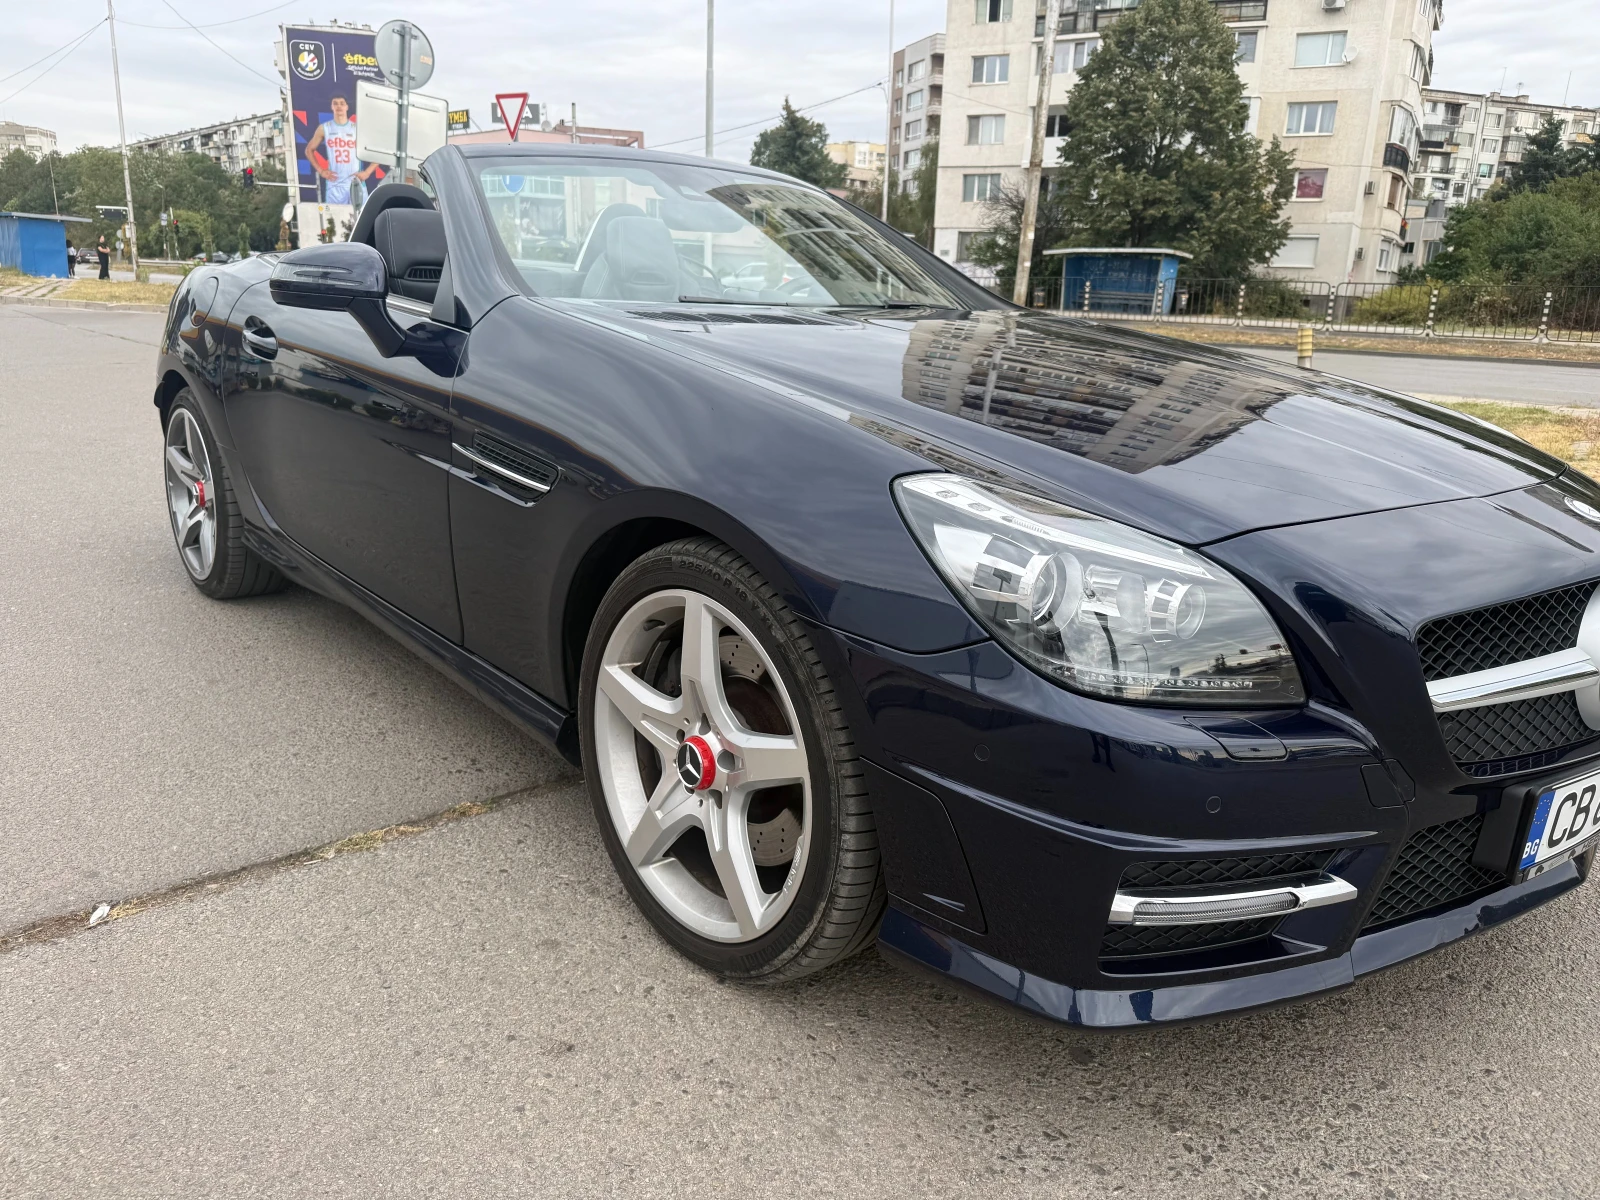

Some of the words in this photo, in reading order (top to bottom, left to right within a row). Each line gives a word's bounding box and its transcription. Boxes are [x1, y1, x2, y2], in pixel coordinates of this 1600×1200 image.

[299, 43, 315, 51] CEV
[335, 149, 350, 164] 23
[679, 560, 721, 582] 225/40
[722, 577, 732, 589] R
[734, 586, 748, 601] 18
[1522, 839, 1540, 859] BG
